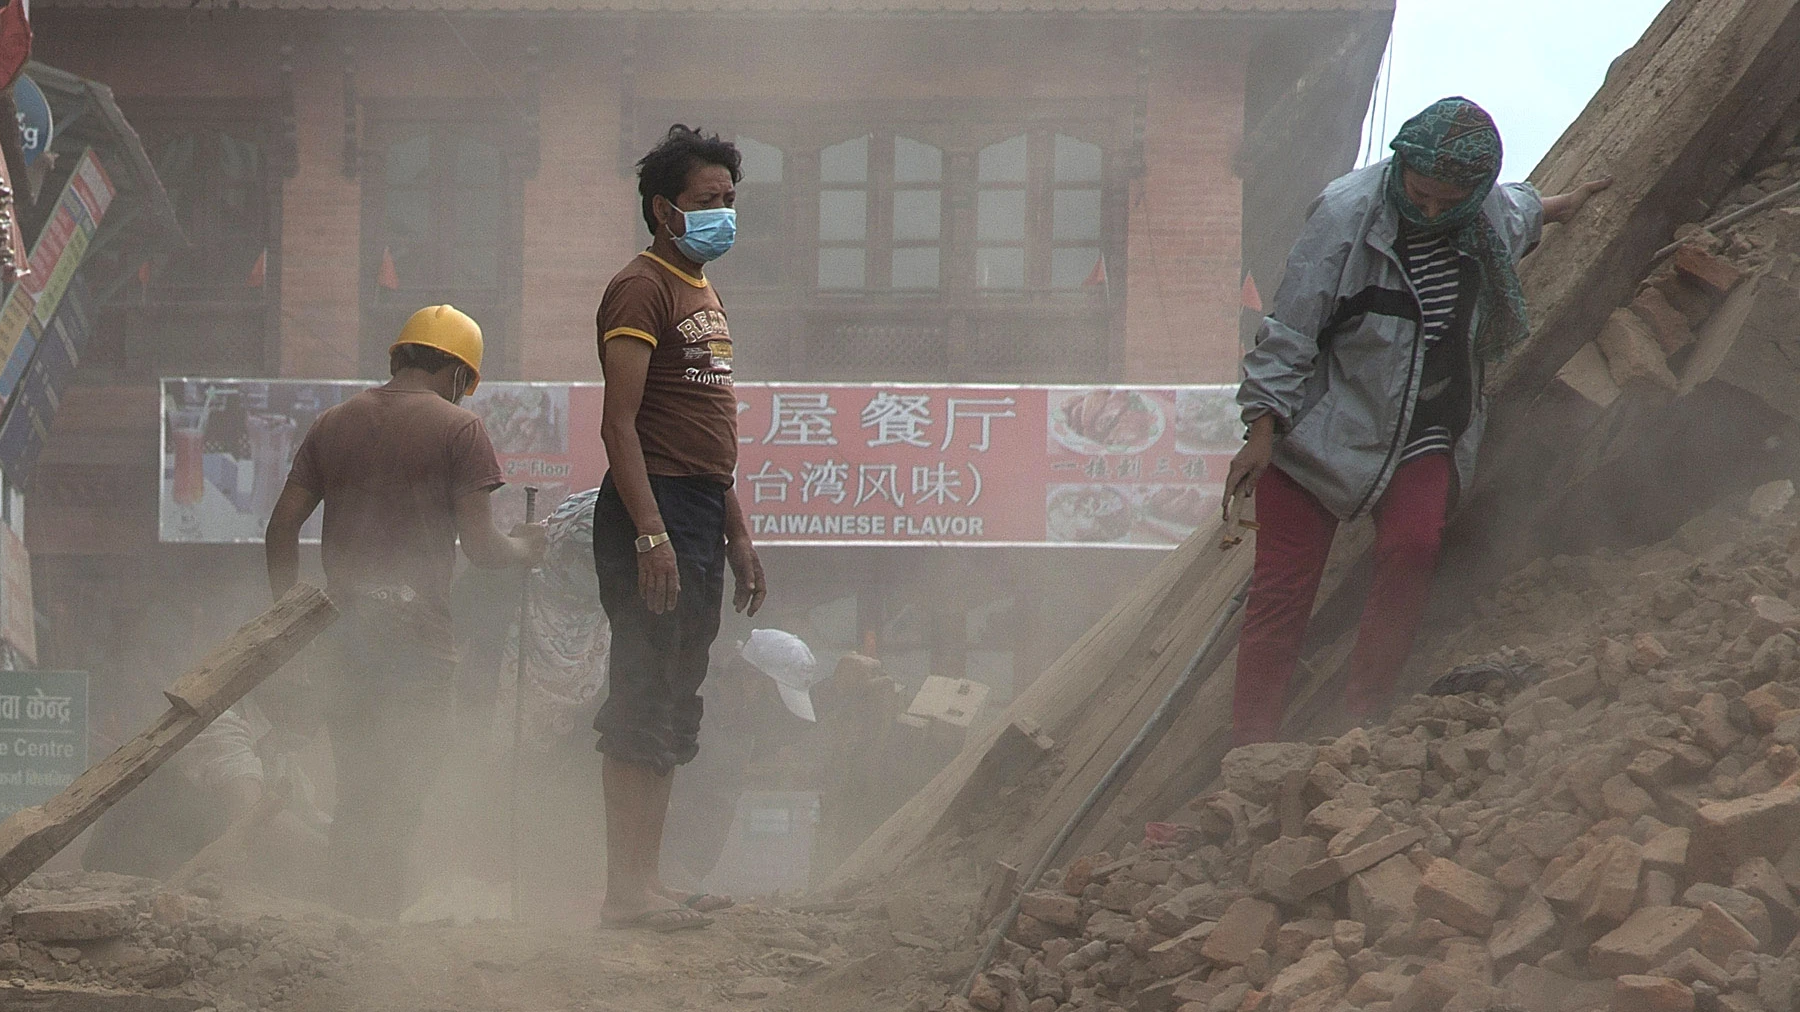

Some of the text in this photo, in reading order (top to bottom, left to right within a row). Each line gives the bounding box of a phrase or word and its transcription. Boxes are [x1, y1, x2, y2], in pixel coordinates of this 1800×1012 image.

[530, 458, 571, 477] Floor
[750, 514, 983, 536] TAIWANESE FLAVOR
[26, 687, 73, 724] केन्द्र
[14, 738, 74, 758] Centre
